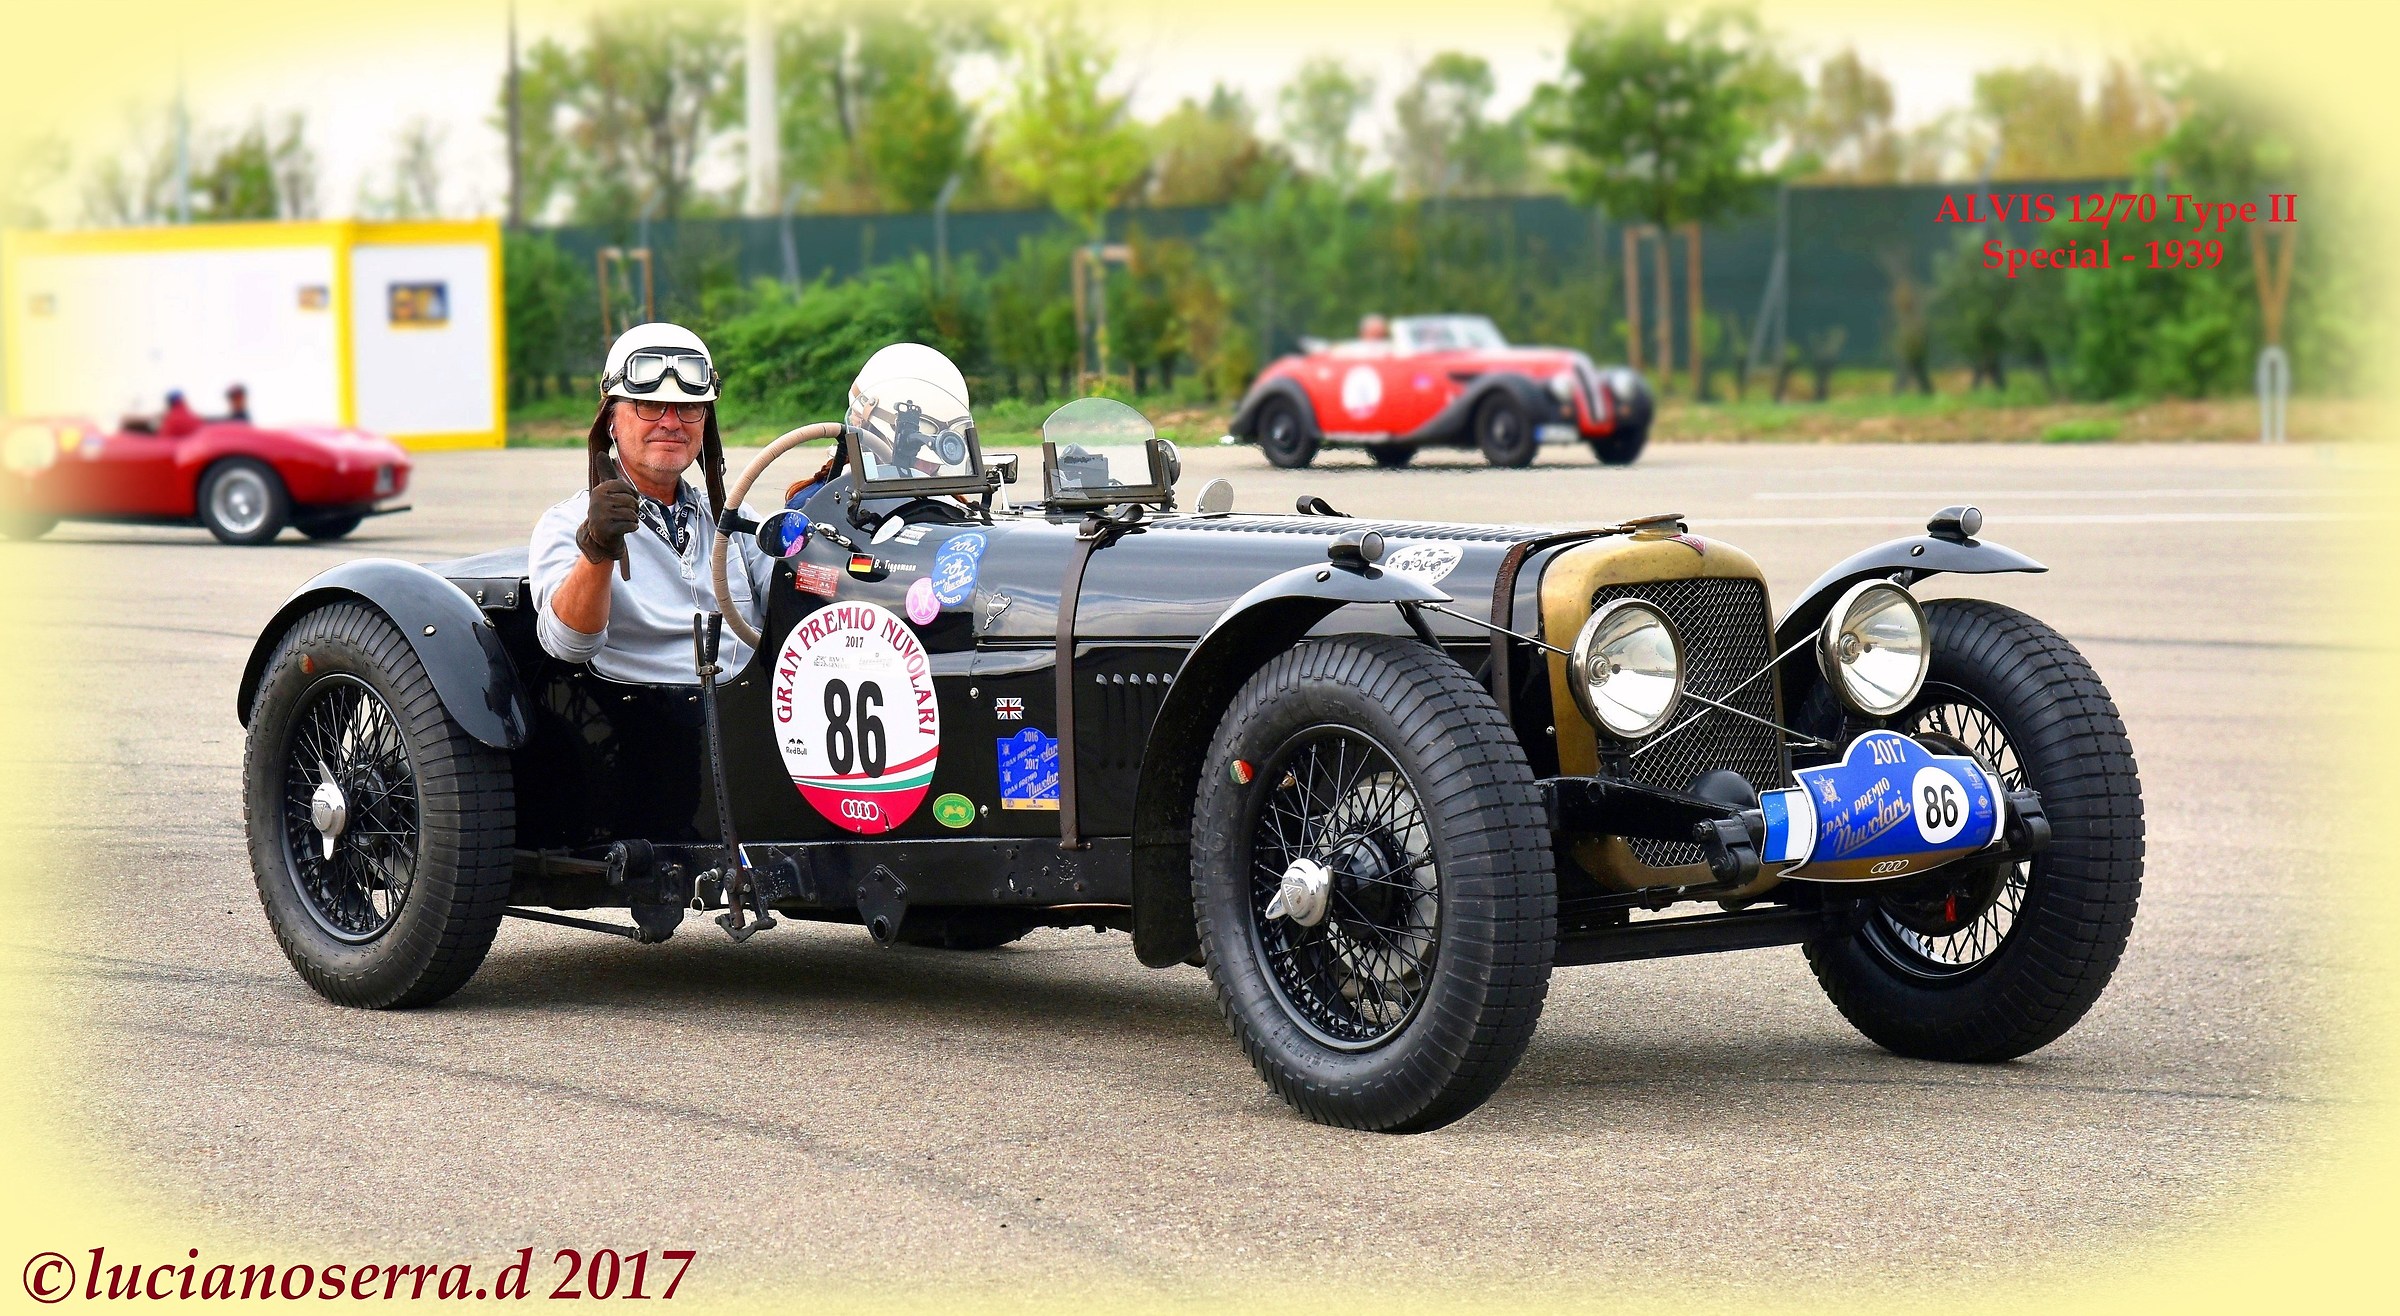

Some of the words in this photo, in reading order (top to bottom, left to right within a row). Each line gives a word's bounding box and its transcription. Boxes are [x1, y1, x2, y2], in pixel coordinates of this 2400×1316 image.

[935, 591, 962, 604] PASSED
[845, 636, 864, 649] 2017
[777, 646, 803, 724] GRAN
[797, 607, 875, 651] PREMIO
[880, 617, 936, 737] NUVOLARI
[823, 678, 887, 779] 86
[1023, 731, 1039, 743] 2016
[1024, 758, 1040, 770] 2017
[1866, 738, 1907, 765] 2017
[1026, 770, 1059, 798] Nuvolar
[1854, 777, 1891, 816] PREMIO
[1923, 784, 1959, 829] 86
[1833, 789, 1911, 858] Nuvolari
